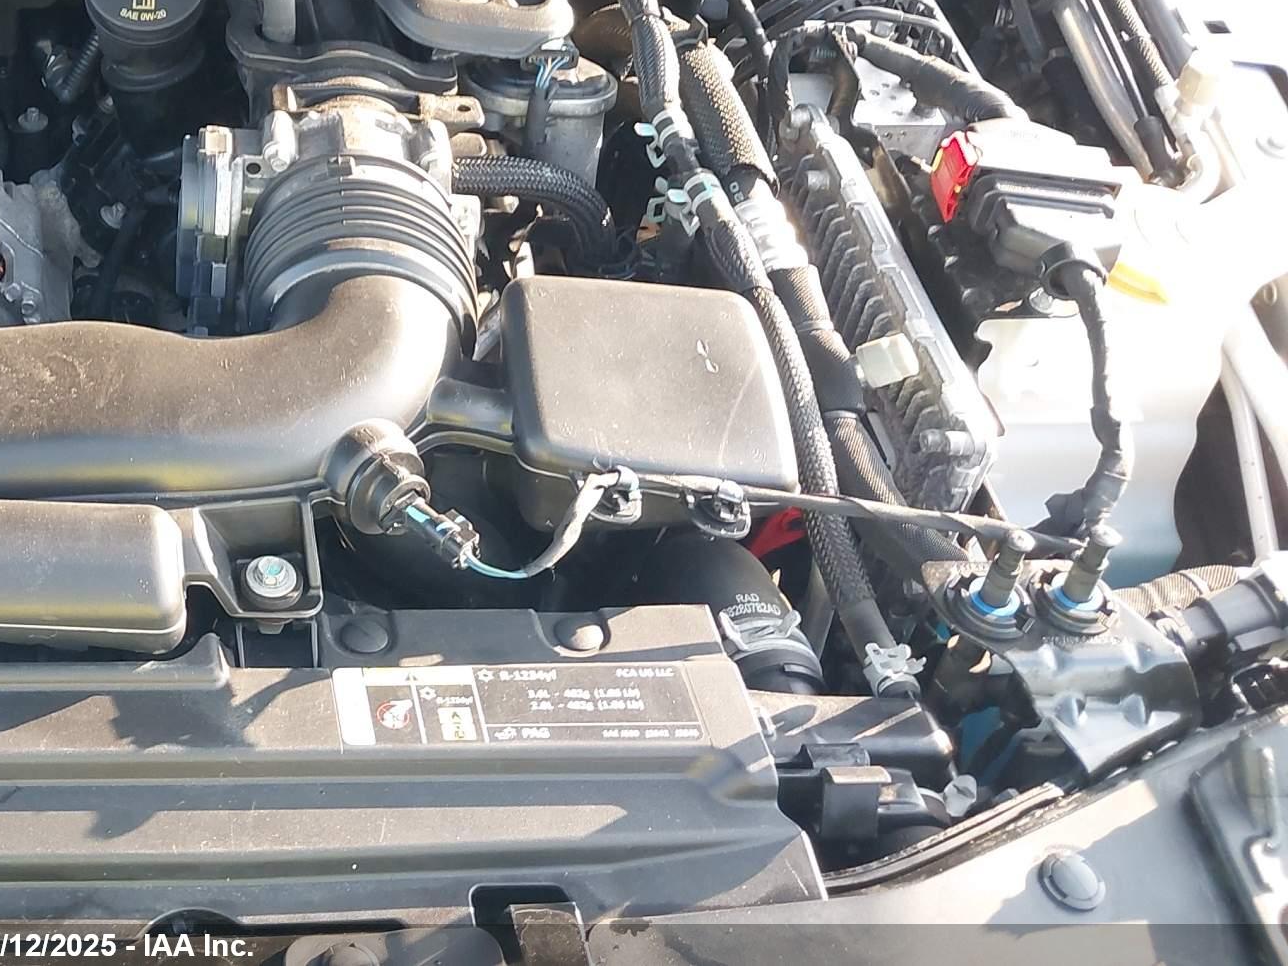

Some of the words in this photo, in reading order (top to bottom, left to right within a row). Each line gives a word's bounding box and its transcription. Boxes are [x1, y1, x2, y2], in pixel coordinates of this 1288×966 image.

[120, 8, 140, 22] SAE
[140, 8, 167, 22] 0W-20
[735, 593, 760, 604] RAD
[615, 668, 638, 678] FCA
[639, 668, 655, 678] US
[655, 668, 675, 678] LLC
